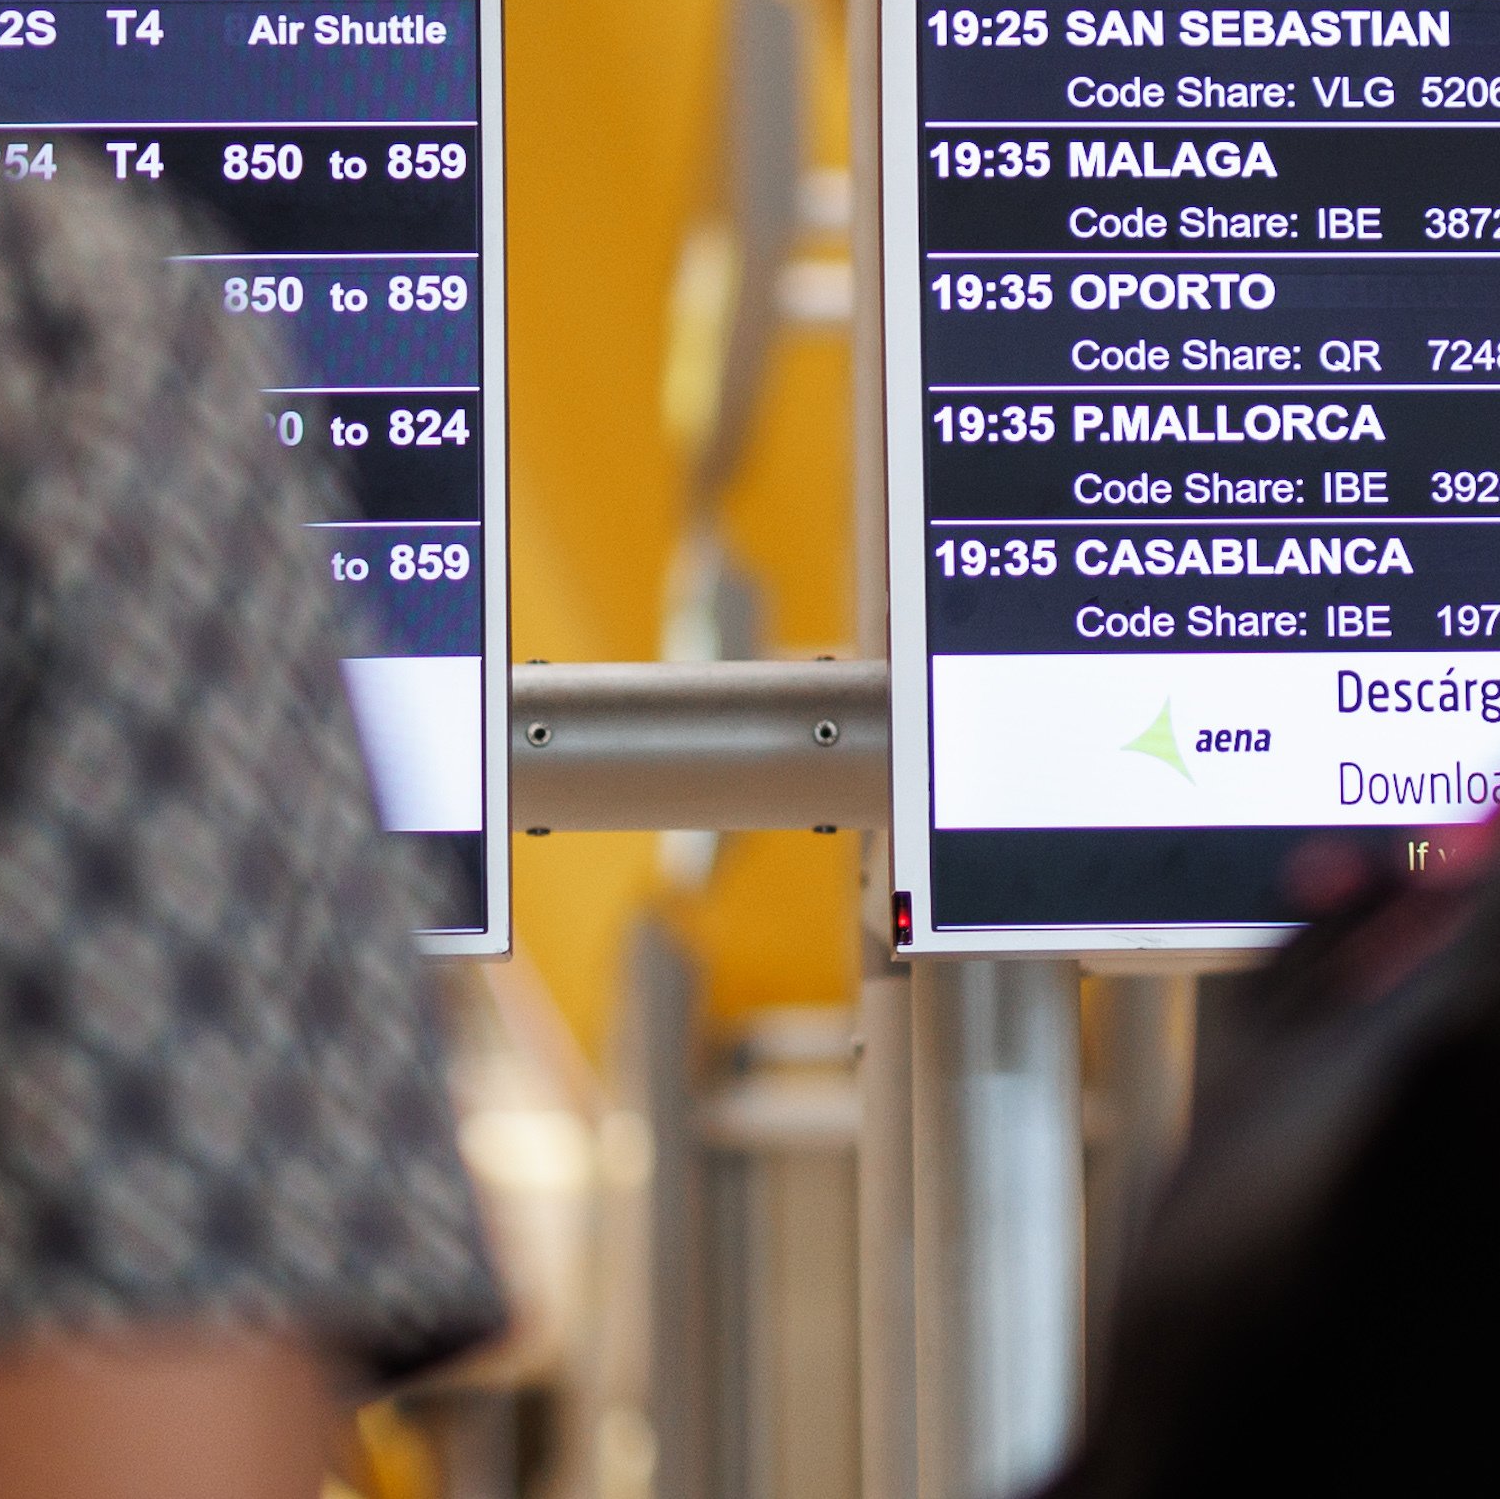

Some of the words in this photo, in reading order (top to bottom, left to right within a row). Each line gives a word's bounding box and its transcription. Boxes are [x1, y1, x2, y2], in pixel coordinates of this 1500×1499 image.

[106, 9, 165, 46] T4
[247, 14, 305, 45] Air
[314, 14, 447, 45] Shuttle
[927, 9, 1049, 47] 19:25
[1066, 10, 1164, 47] SAN
[1179, 10, 1450, 47] SEBASTIAN
[1067, 76, 1165, 108] Code
[1176, 76, 1296, 108] Share:
[1312, 76, 1395, 108] VLG
[930, 141, 1051, 178] 19:35
[1069, 141, 1278, 178] MALAGA
[224, 276, 304, 313] 850
[329, 282, 368, 312] to
[388, 275, 468, 312] 859
[931, 273, 1053, 311] 19:35
[1070, 273, 1276, 310] OPORTO
[1071, 339, 1170, 371] Code
[1182, 339, 1302, 371] Share:
[1319, 340, 1382, 373] QR
[933, 405, 1055, 442] 19:35
[1073, 404, 1386, 442] P.MALLORCA
[331, 551, 369, 581] to
[389, 543, 470, 581] 859
[935, 539, 1058, 577] 19:35
[1075, 537, 1414, 576] CASABLANCA
[1076, 605, 1175, 638] Code
[1187, 605, 1307, 637] Share:
[1327, 605, 1393, 637] IBE
[1195, 729, 1272, 753] aena
[1408, 841, 1430, 871] If
